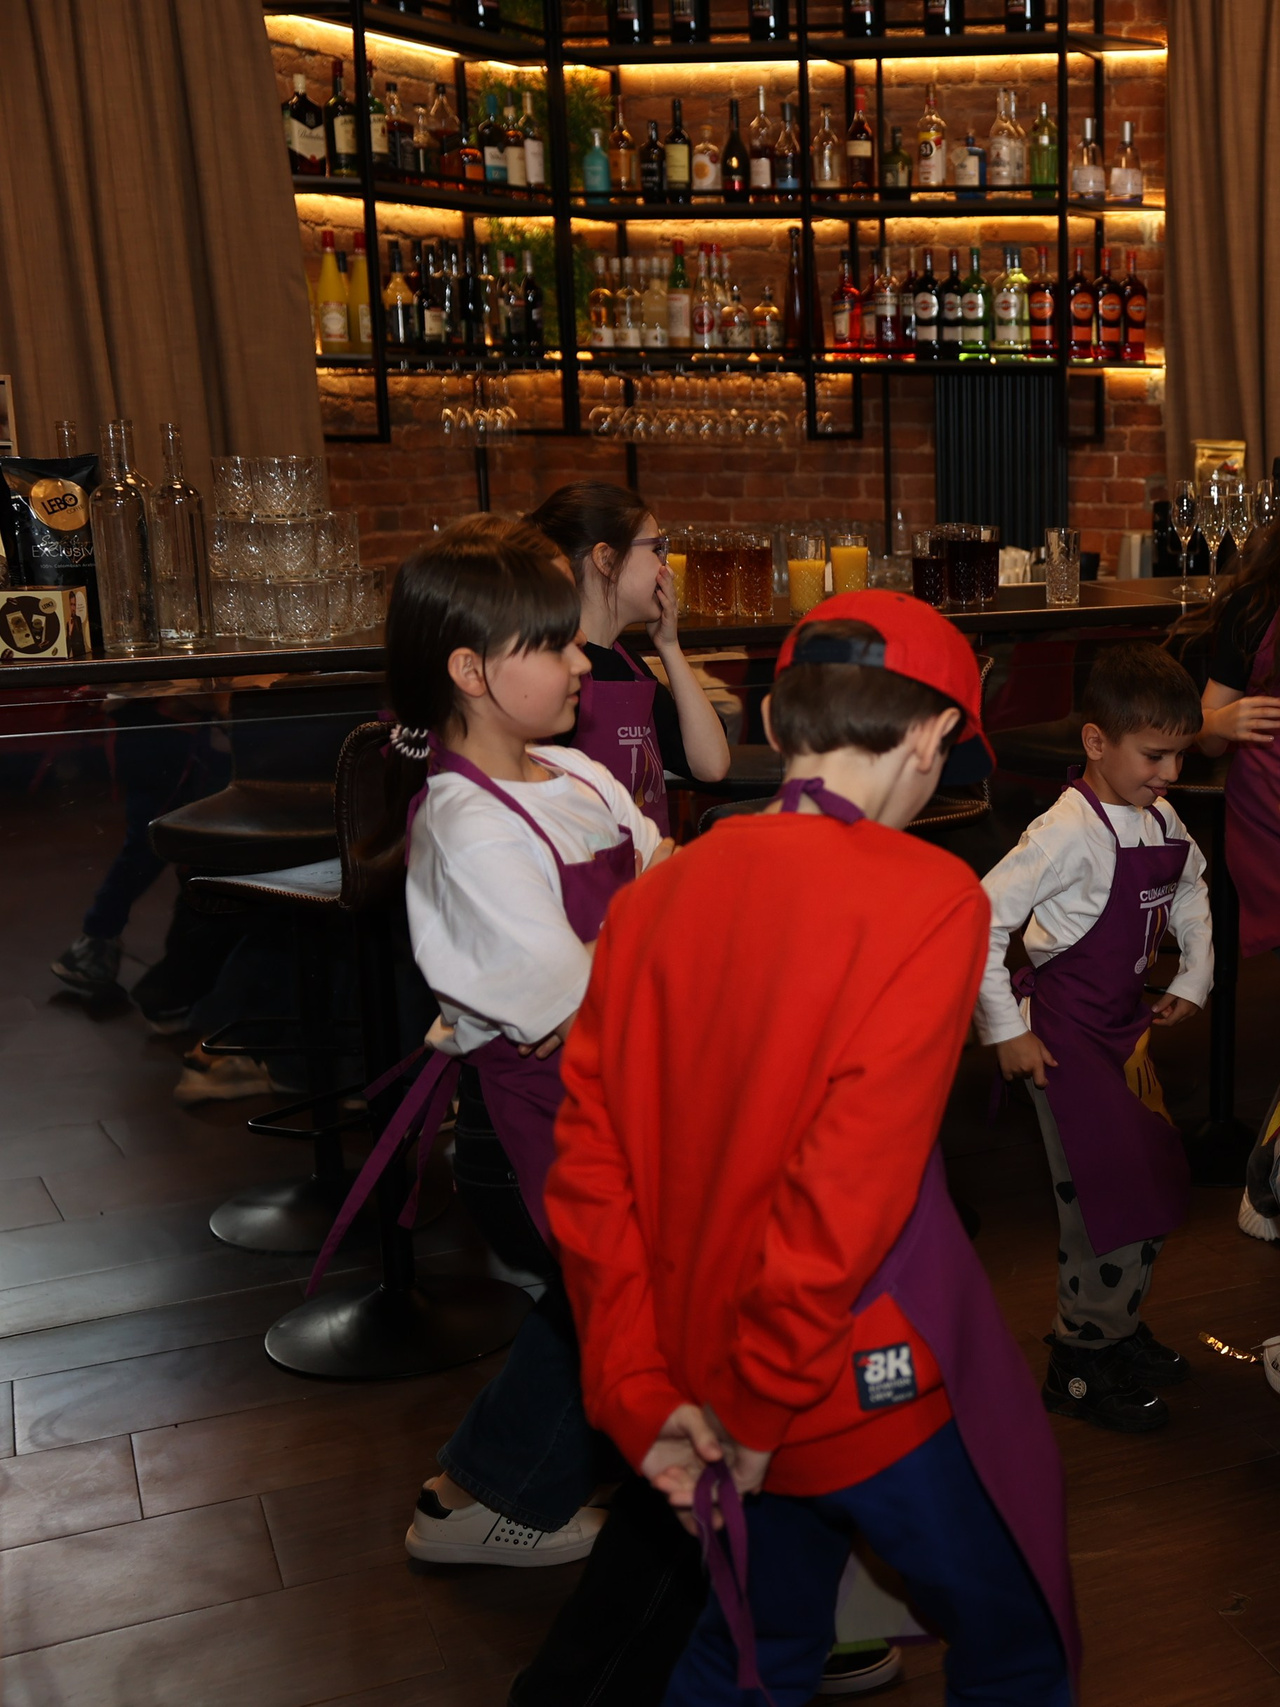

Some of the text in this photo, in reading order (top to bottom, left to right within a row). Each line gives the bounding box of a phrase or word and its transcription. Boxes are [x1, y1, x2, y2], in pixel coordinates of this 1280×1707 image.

[920, 143, 932, 156] 51
[41, 493, 78, 515] LEBO
[32, 545, 94, 558] EXCLUSIV
